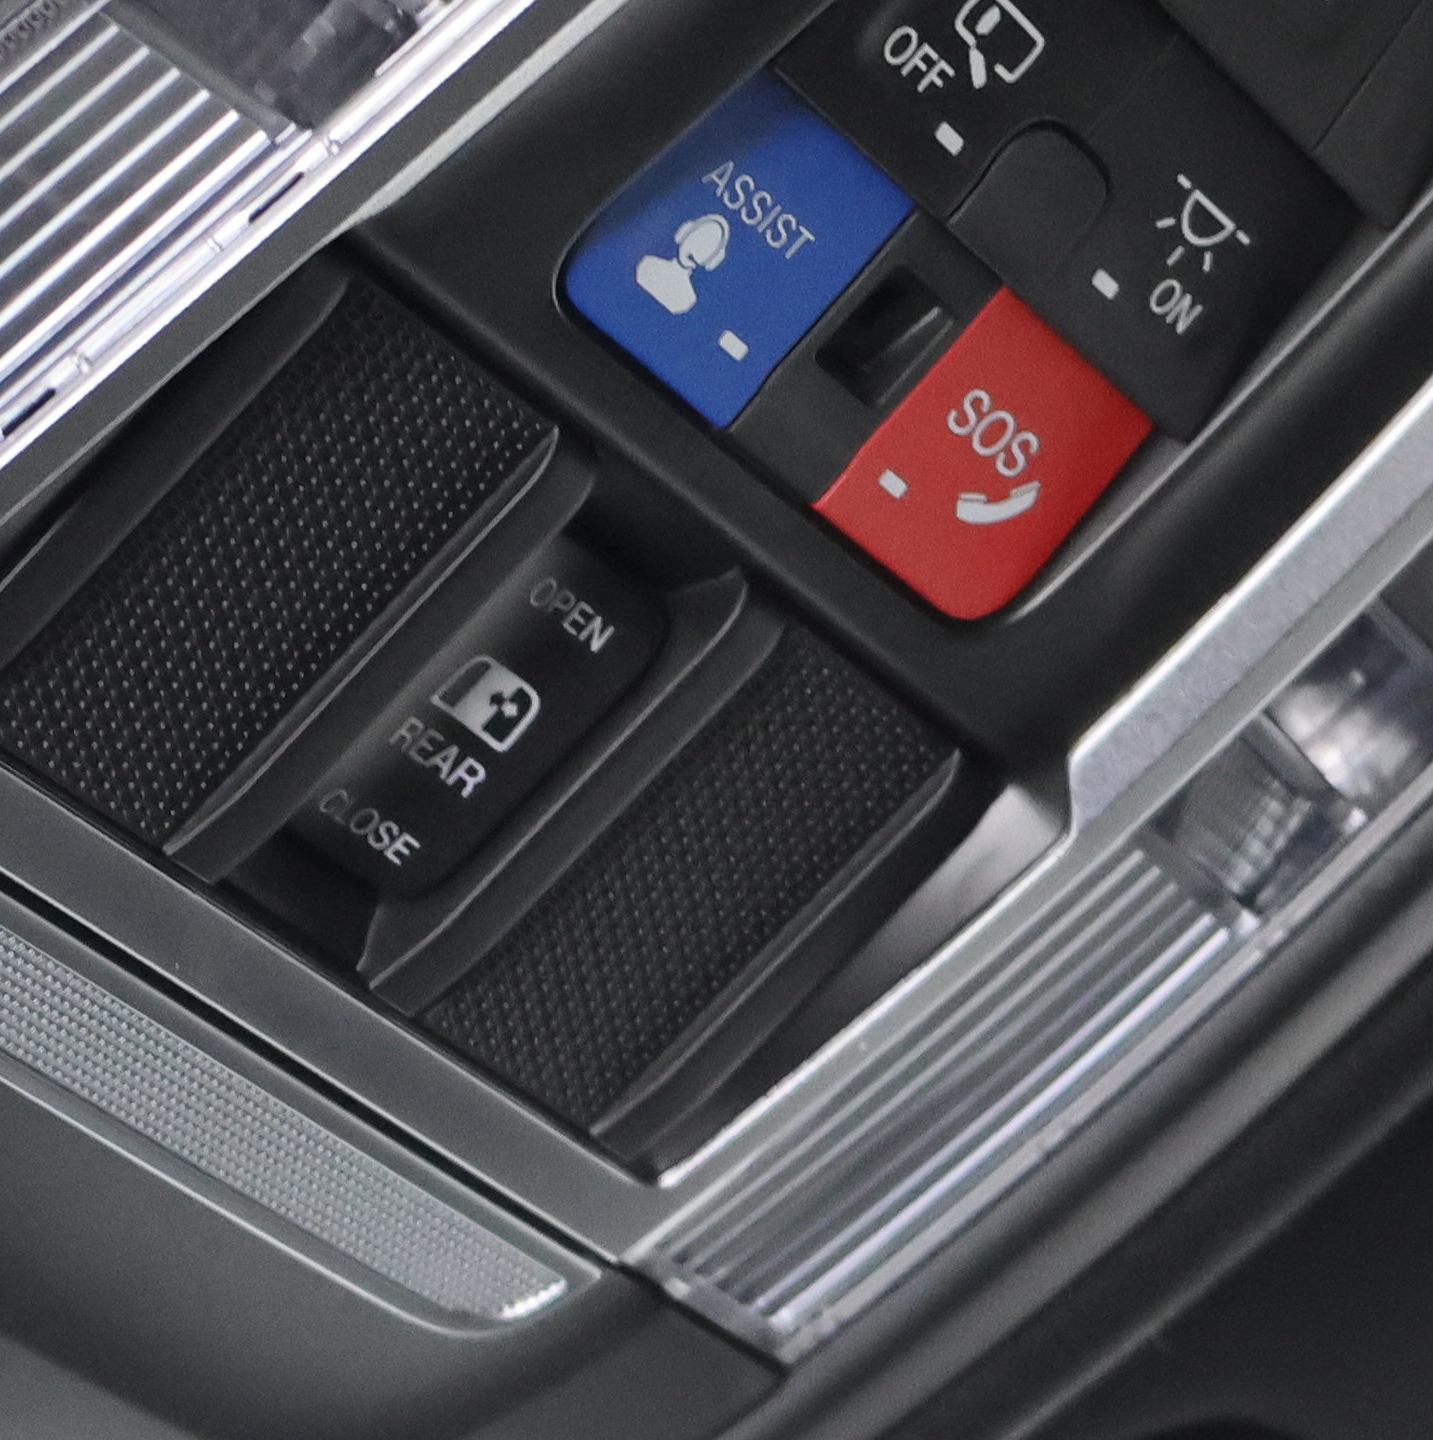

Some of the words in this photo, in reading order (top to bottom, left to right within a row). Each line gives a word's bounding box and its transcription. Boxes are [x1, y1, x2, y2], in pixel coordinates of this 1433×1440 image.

[883, 24, 956, 94] OFF
[700, 160, 816, 259] ASSIST
[1149, 278, 1204, 335] ON
[946, 388, 1041, 477] SOS
[530, 576, 615, 654] OPEN
[389, 716, 487, 799] REAR
[318, 788, 421, 866] CLOSE
